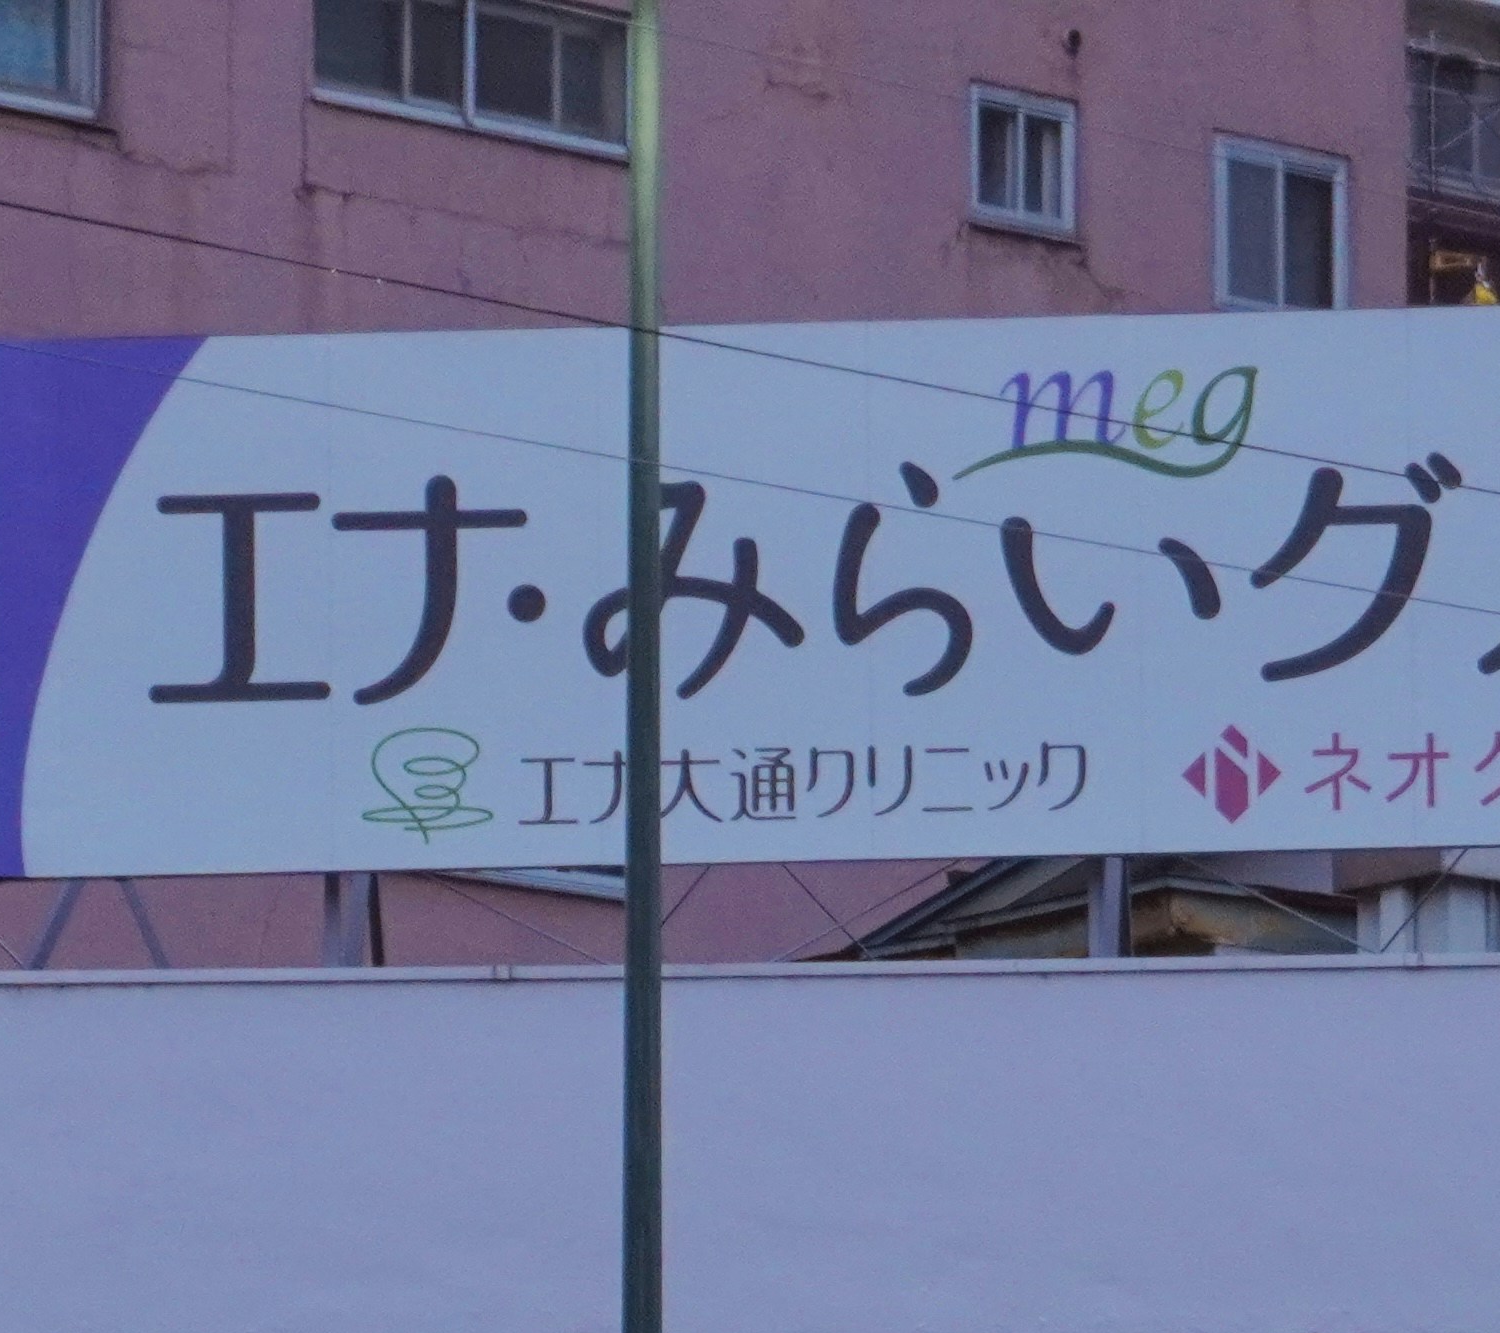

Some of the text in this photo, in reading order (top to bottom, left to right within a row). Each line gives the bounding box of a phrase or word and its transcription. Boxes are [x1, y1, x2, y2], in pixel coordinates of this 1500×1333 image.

[998, 366, 1258, 478] meg
[518, 742, 1087, 826] エナ大通クリニック
